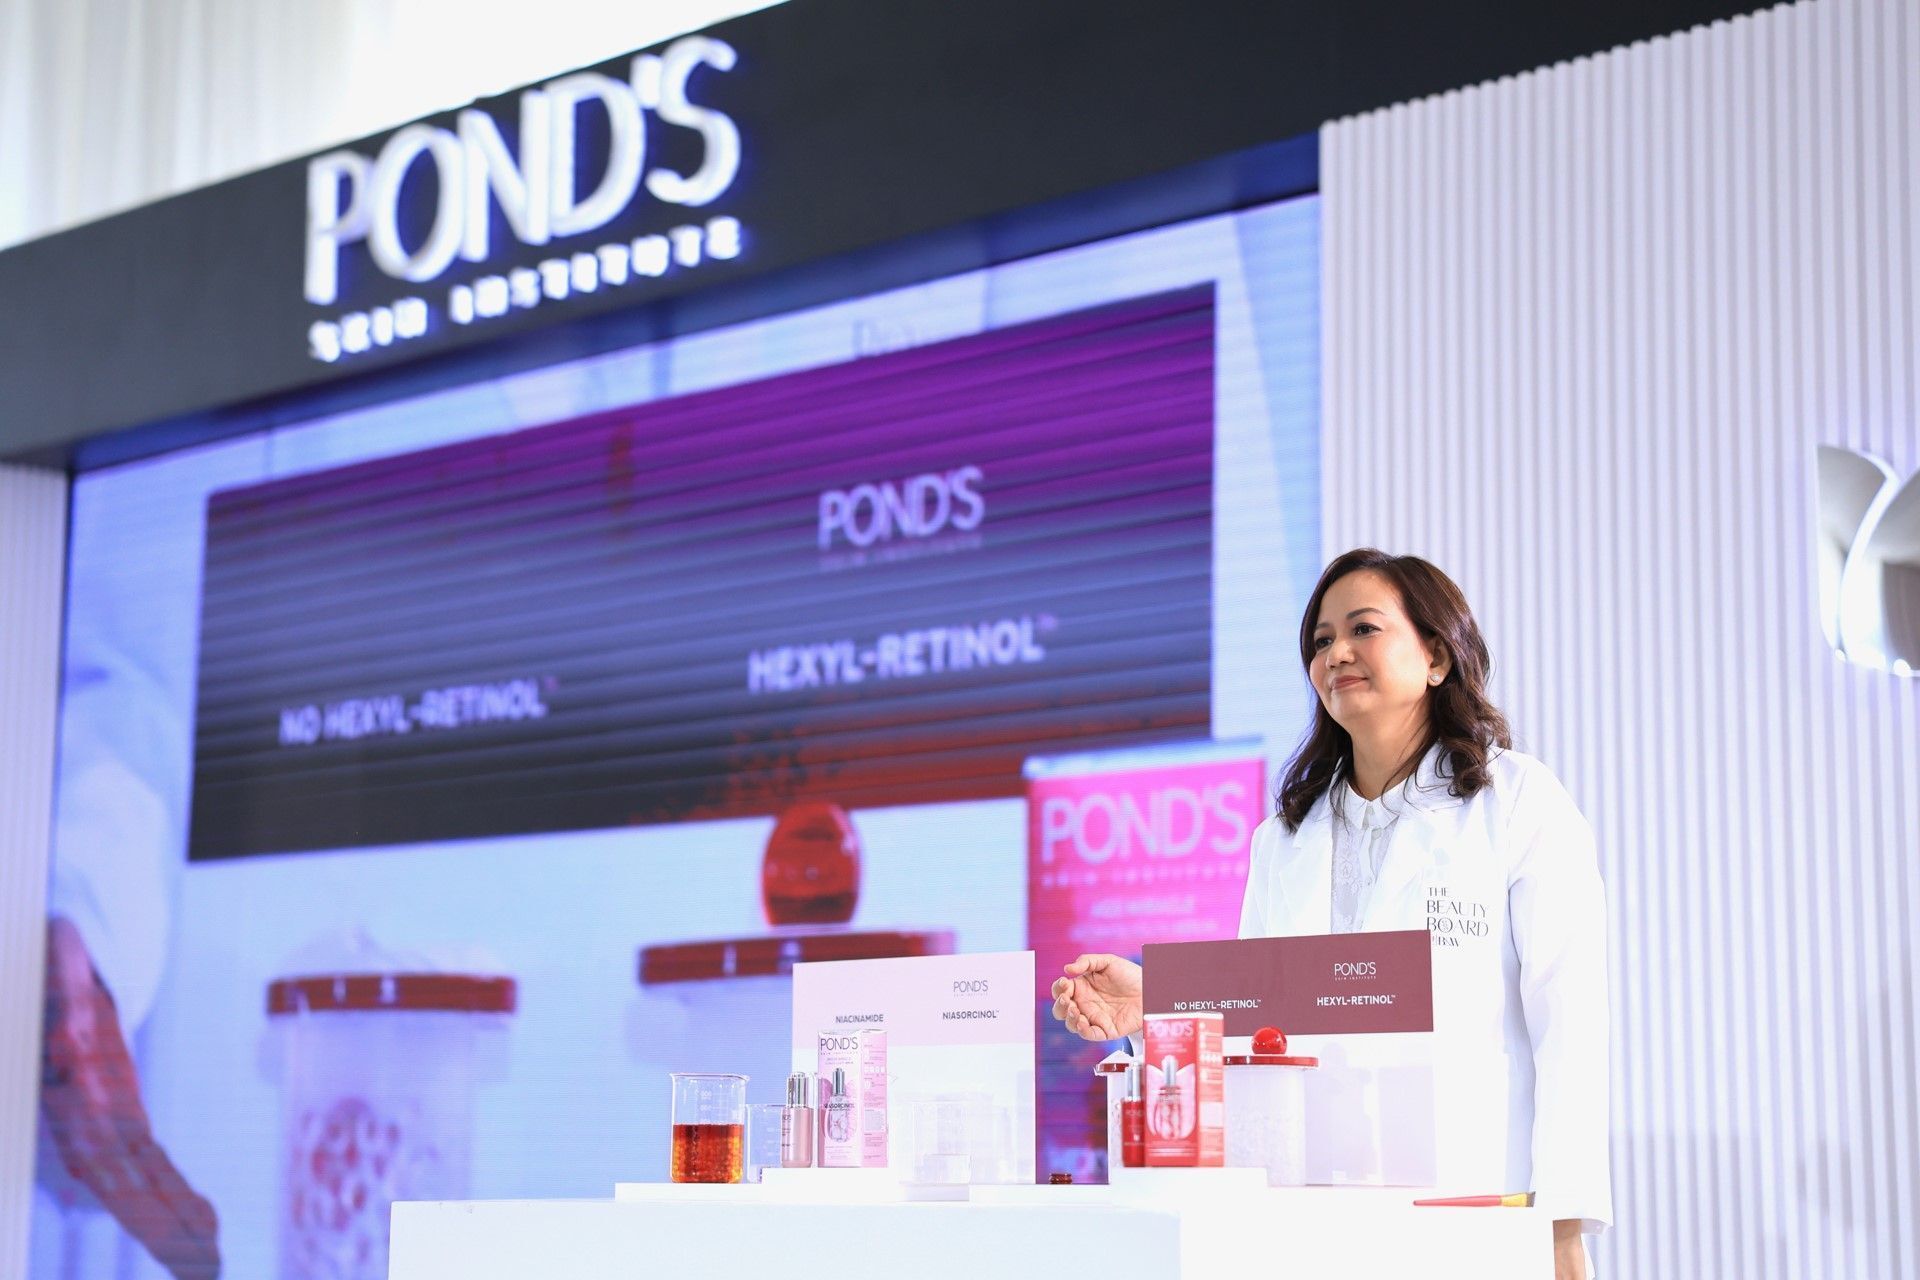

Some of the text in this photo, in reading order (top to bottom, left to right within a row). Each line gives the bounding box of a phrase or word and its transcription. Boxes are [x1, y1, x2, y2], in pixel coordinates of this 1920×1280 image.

[304, 34, 742, 305] POND'S
[817, 464, 985, 550] POND'S
[278, 704, 322, 746] NO
[1040, 781, 1249, 864] POND'S
[1428, 886, 1449, 897] THE
[1427, 900, 1487, 918] BEAUTY
[1427, 916, 1489, 937] BOARD
[1334, 961, 1377, 976] POND'S
[953, 979, 989, 993] POND'S
[1174, 1001, 1187, 1011] NO
[835, 1013, 884, 1025] NIACINAMIDE
[820, 1036, 859, 1051] POND'S
